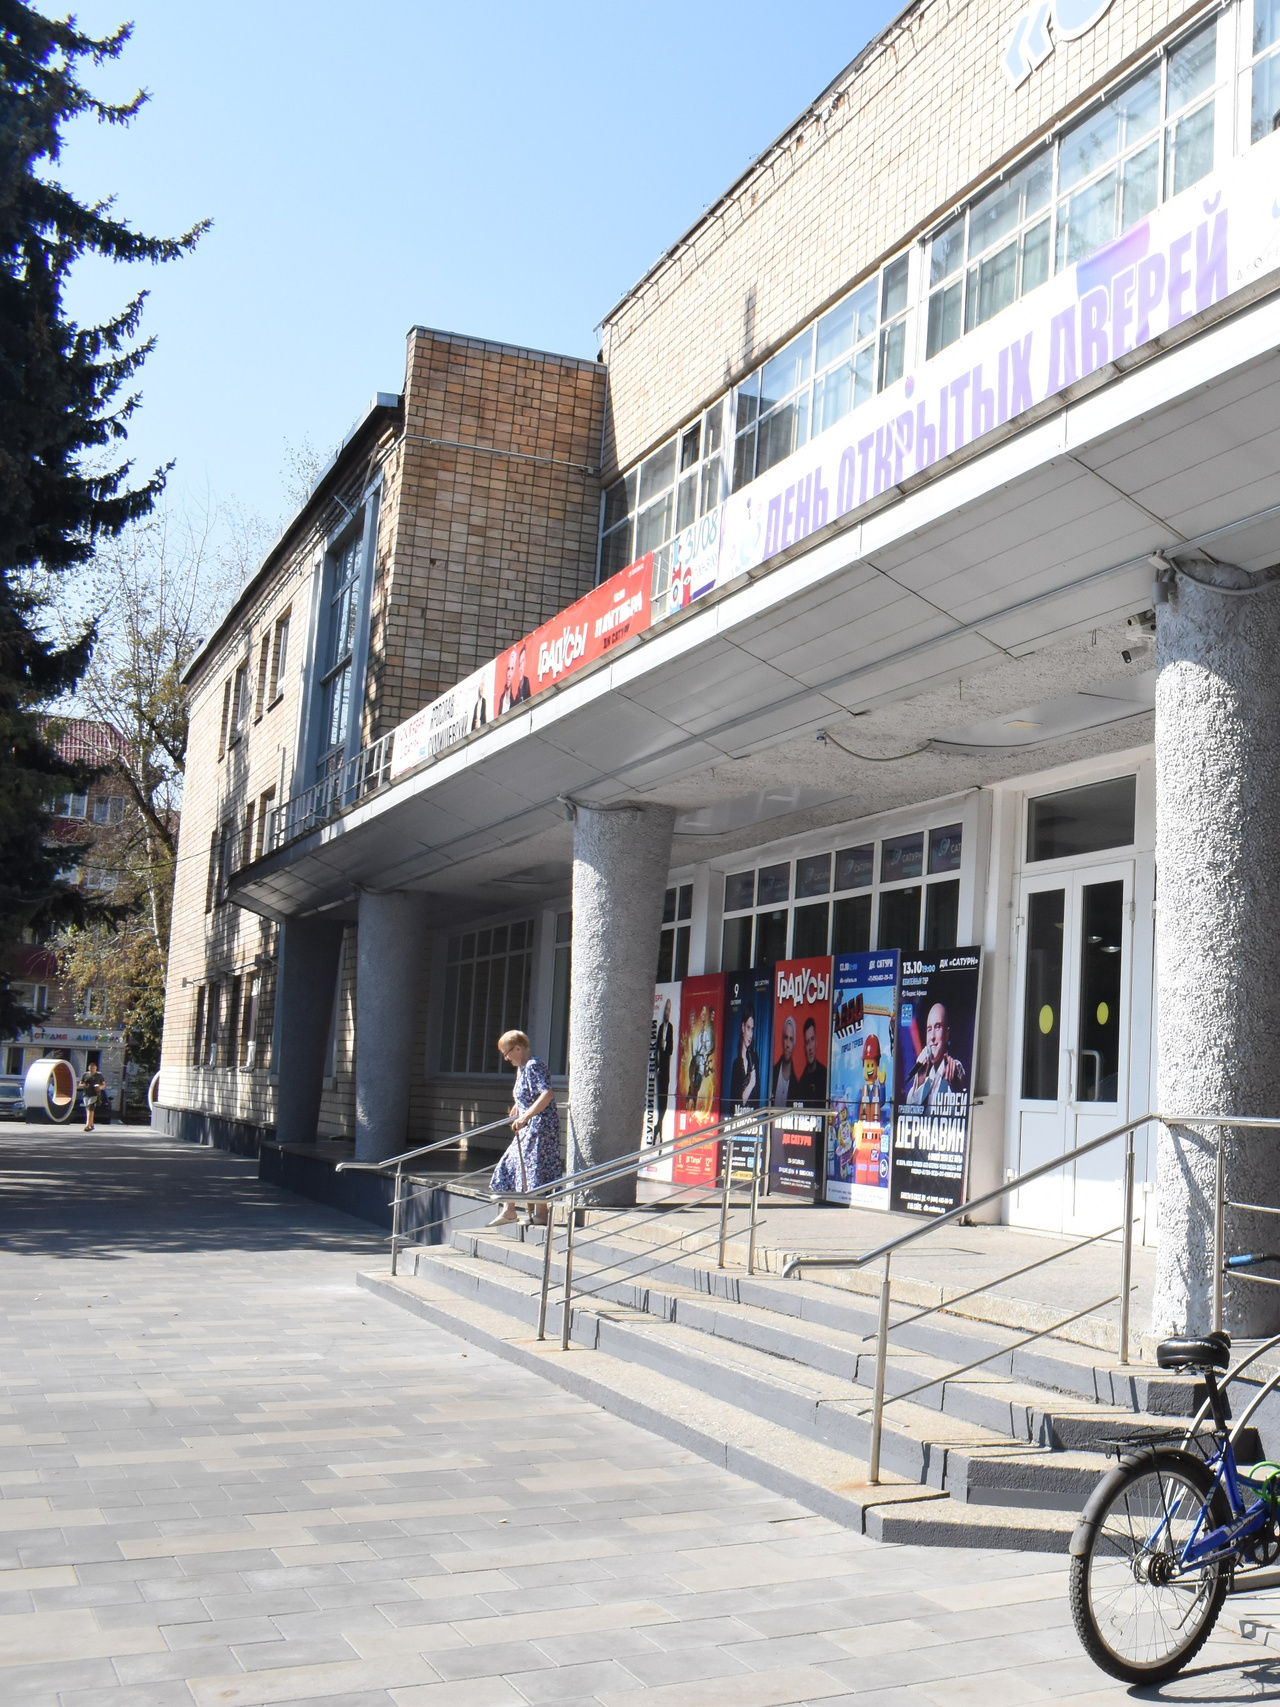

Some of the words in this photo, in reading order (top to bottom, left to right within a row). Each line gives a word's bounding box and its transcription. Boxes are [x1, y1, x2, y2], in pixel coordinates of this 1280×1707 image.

[762, 466, 829, 562] ДЕНЬ
[836, 330, 1033, 518] ОТКРЫТЫХ
[1044, 190, 1229, 399] ДВЕРЕЙ
[685, 508, 719, 565] 31/08
[537, 623, 588, 682] ГРАДУСЫ
[903, 961, 922, 974] 13.10
[940, 960, 948, 968] ДК
[949, 957, 978, 967] «САТУРН»
[734, 984, 739, 998] 9
[777, 967, 829, 1007] ГРАДУСЫ
[34, 1032, 67, 1040] СТУДИЯ
[931, 1088, 968, 1116] АНДРЕЙ
[895, 1115, 965, 1153] ДЕРЖАВИН
